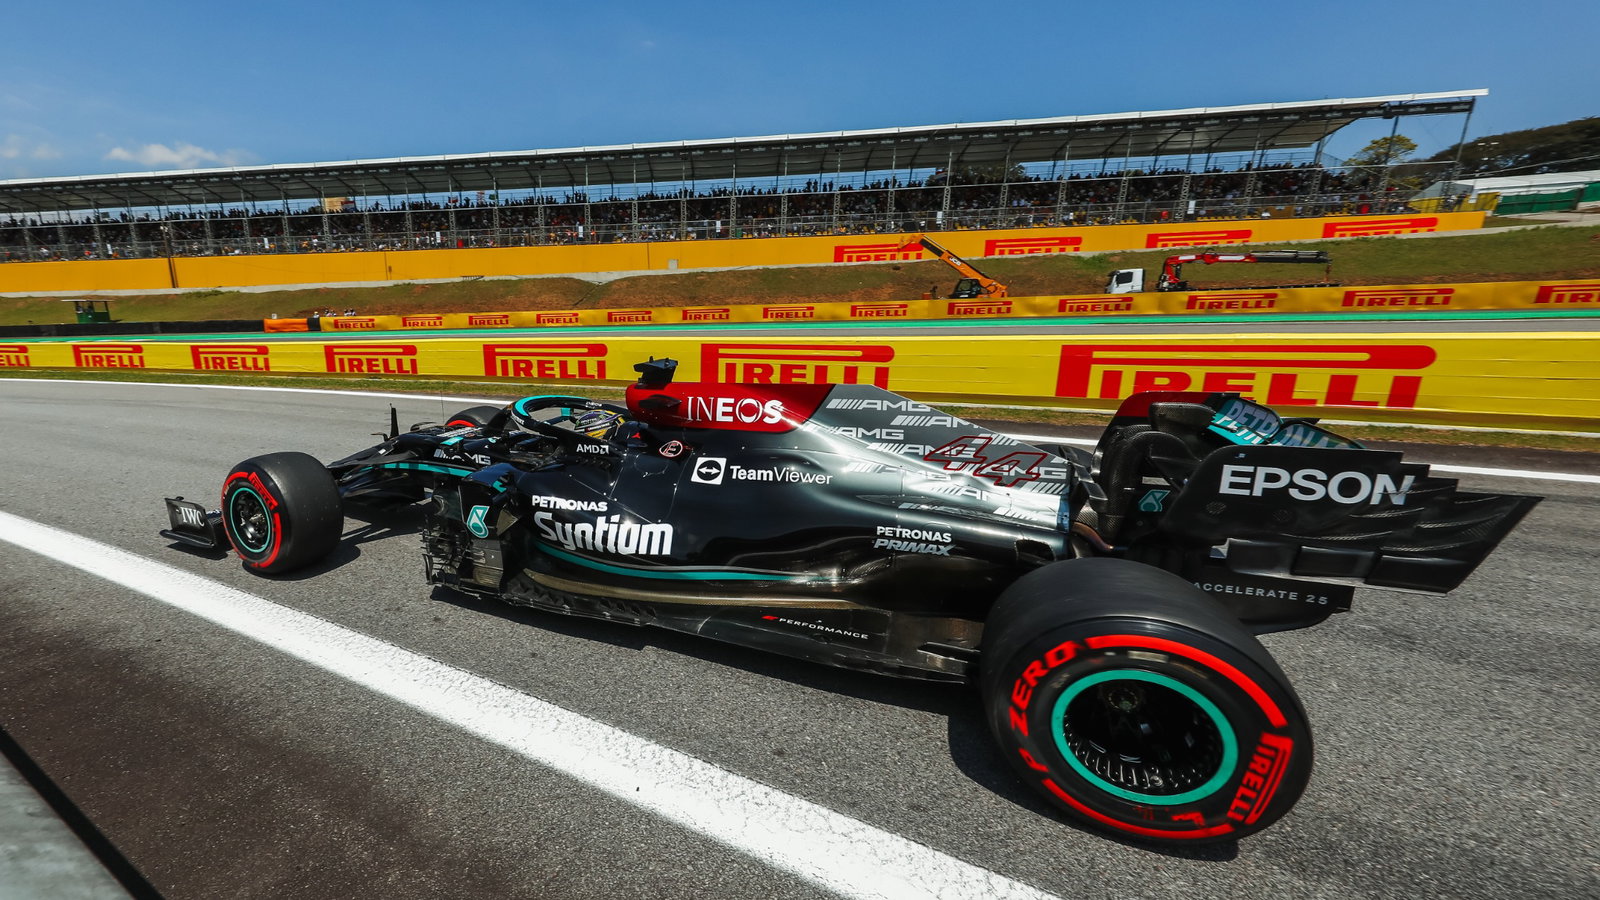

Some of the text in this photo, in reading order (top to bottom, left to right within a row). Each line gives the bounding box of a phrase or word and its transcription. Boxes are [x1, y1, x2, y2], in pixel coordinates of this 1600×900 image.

[1186, 293, 1279, 310] PIRELLI
[1342, 288, 1455, 308] PIRELLI
[1535, 284, 1600, 304] PIR
[682, 308, 730, 321] PIRELLI
[763, 306, 814, 319] PIRELLI
[851, 304, 908, 318] PIRELLI
[947, 301, 1013, 316] PIRELLI
[1058, 297, 1134, 313] PIRELLI
[333, 318, 375, 329] PIRELLI
[402, 316, 443, 328] PIRELLI
[469, 314, 509, 326] PIRELLI
[536, 312, 579, 324] PIRELLI
[608, 310, 652, 323] PIRELLI
[72, 345, 145, 369] PIRELLI
[190, 345, 270, 372] PIRELLI
[324, 345, 418, 375] PIRELLI
[482, 344, 608, 380] PIRELLI
[700, 343, 895, 391] PIRELLI
[1055, 345, 1437, 409] PIRELLI
[686, 396, 784, 424] INEOS
[927, 415, 982, 429] AM
[839, 427, 904, 440] AMG
[576, 443, 600, 454] AMD
[923, 435, 1049, 488] 44
[730, 465, 833, 486] TeamViewer
[1218, 464, 1416, 506] EPSON
[532, 495, 608, 512] PETRONAS
[180, 506, 205, 527] IWC
[533, 512, 674, 556] Syntium
[876, 526, 952, 544] PETRONAS
[873, 538, 955, 556] PRIMAX
[1193, 582, 1329, 605] ACCELERATE 25
[778, 617, 869, 640] PERFORMANCE
[1008, 640, 1080, 737] ZERO
[1226, 731, 1294, 826] PIRELLI
